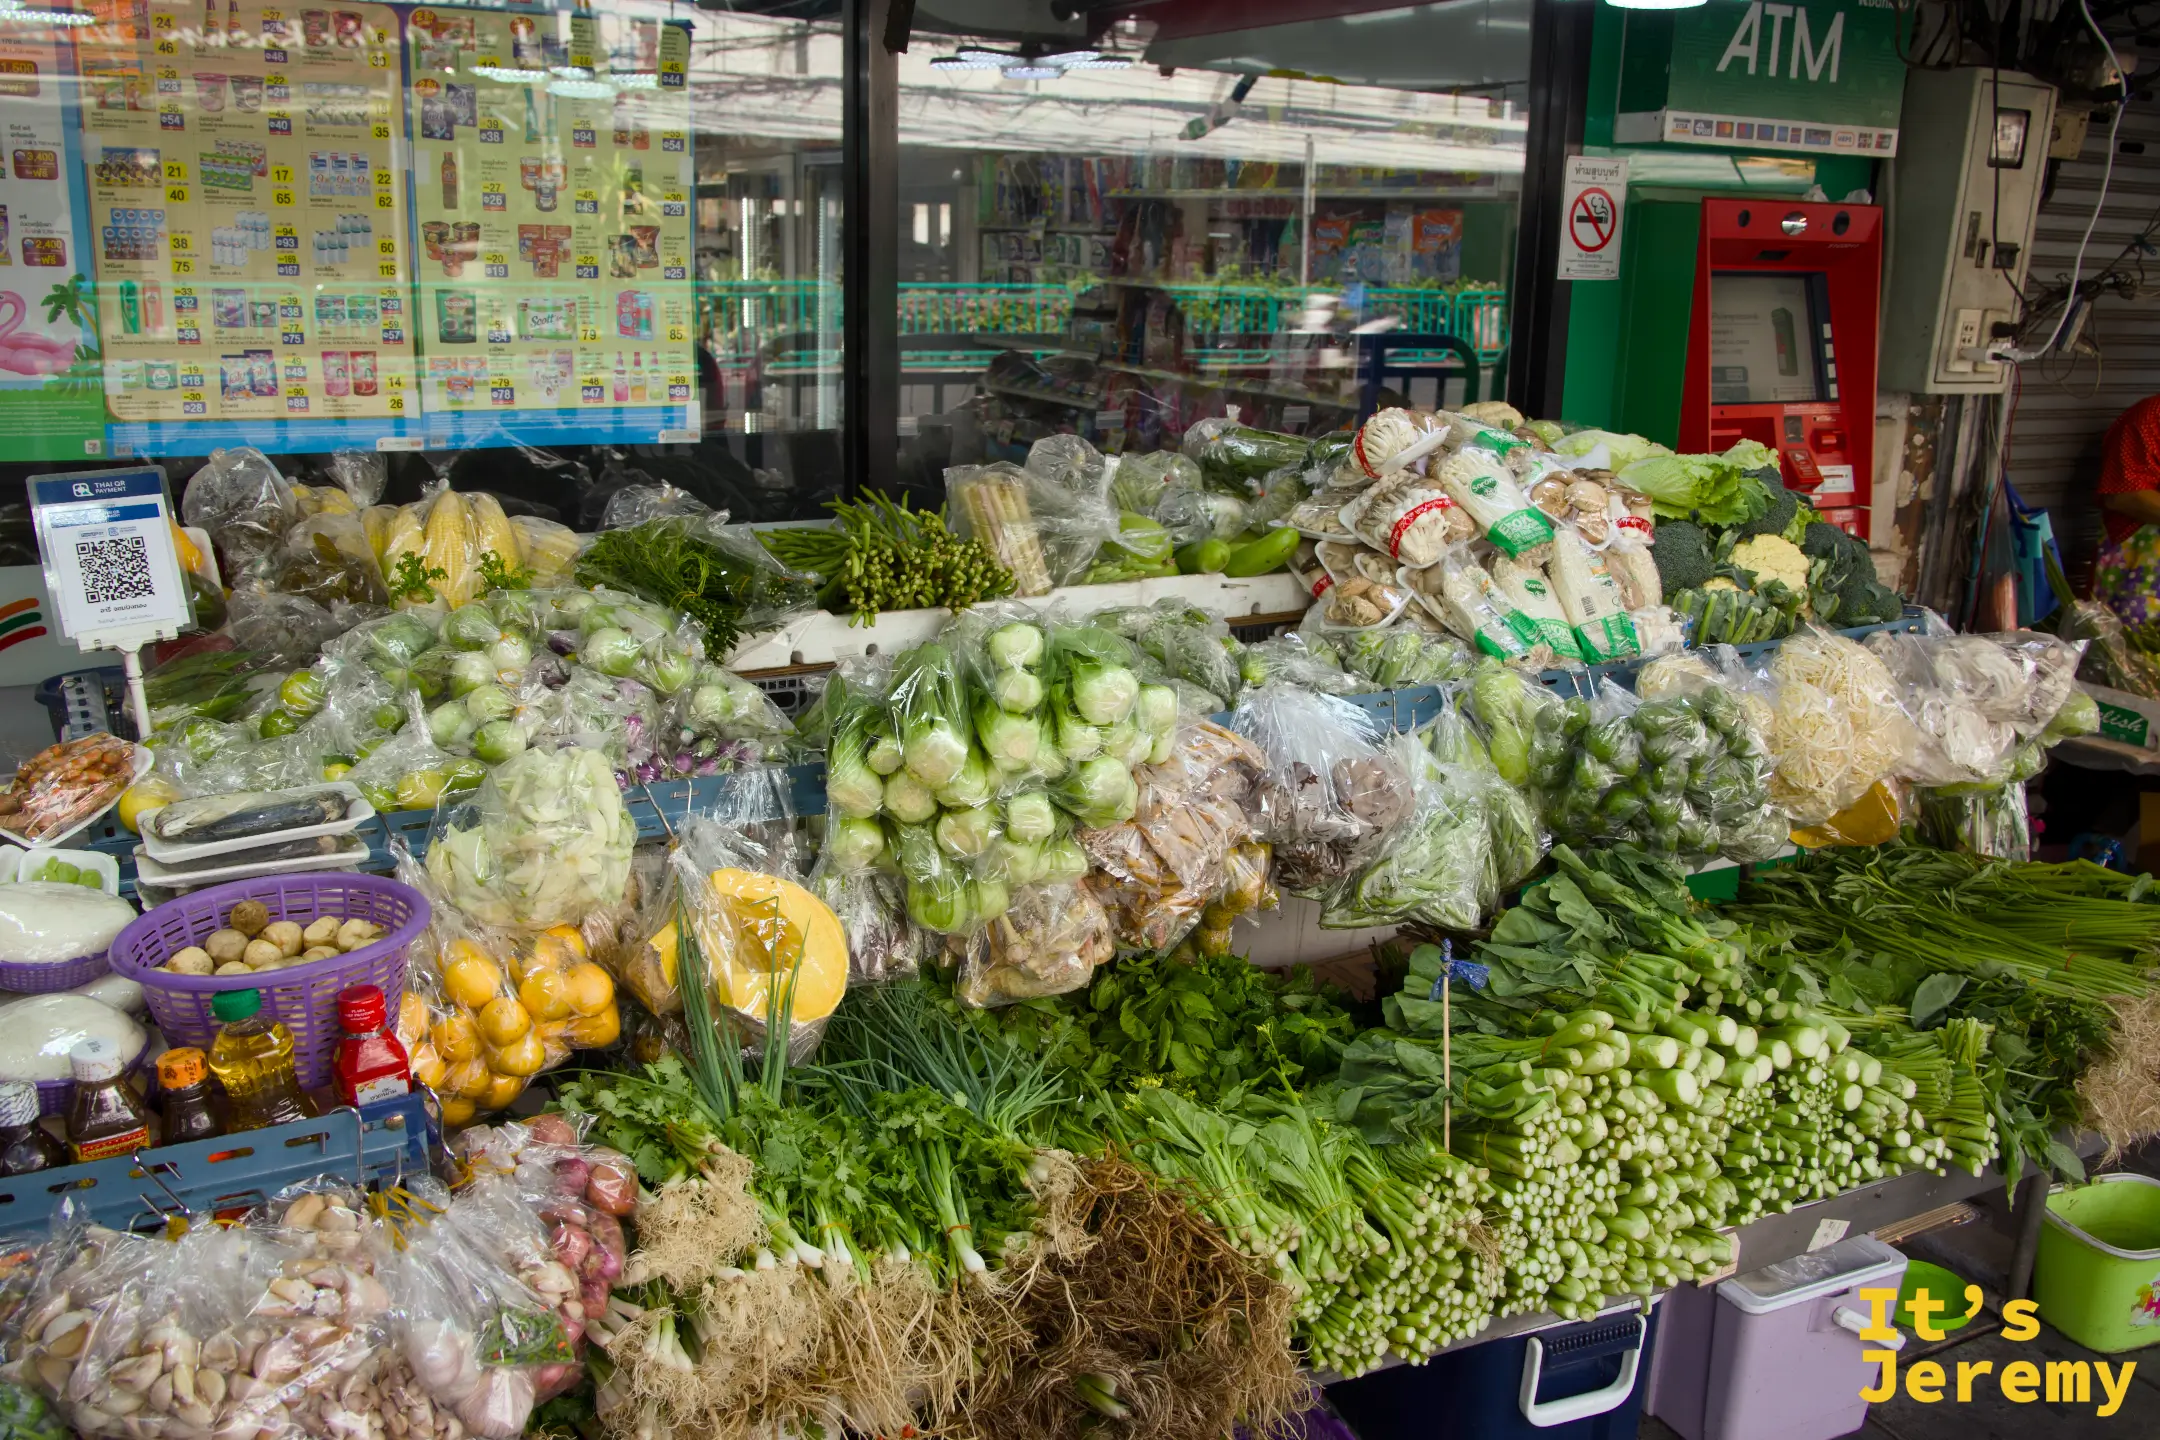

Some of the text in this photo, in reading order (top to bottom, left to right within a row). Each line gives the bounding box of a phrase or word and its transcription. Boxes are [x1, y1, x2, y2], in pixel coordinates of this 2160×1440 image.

[269, 11, 280, 20] 27
[156, 16, 172, 28] 24
[1716, 0, 1845, 83] ATM
[158, 42, 174, 53] 46
[668, 63, 680, 71] 45
[164, 70, 177, 79] 29
[273, 76, 285, 84] 22
[668, 76, 680, 84] 44
[273, 87, 285, 96] 21
[167, 114, 181, 125] 54
[275, 119, 288, 130] 40
[487, 119, 498, 128] 39
[375, 126, 390, 138] 35
[486, 132, 500, 141] 38
[580, 131, 592, 142] 94
[669, 139, 681, 150] 54
[167, 165, 181, 177] 21
[274, 170, 289, 182] 17
[1574, 163, 1620, 181] ห้ามสูบบุหรี่
[377, 173, 391, 185] 22
[490, 183, 501, 193] 27
[169, 190, 185, 201] 40
[276, 193, 291, 204] 65
[583, 190, 594, 199] 46
[671, 193, 682, 202] 30
[378, 196, 393, 208] 62
[490, 195, 503, 205] 26
[581, 202, 594, 212] 45
[670, 205, 682, 215] 29
[282, 227, 294, 236] 94
[35, 238, 62, 250] 2,400
[172, 238, 188, 249] 38
[282, 238, 294, 247] 93
[380, 242, 395, 253] 60
[492, 254, 504, 263] 20
[583, 256, 594, 265] 22
[175, 261, 191, 272] 75
[379, 264, 396, 275] 115
[492, 267, 505, 277] 19
[583, 268, 595, 277] 21
[670, 268, 682, 278] 25
[181, 287, 193, 296] 33
[386, 289, 397, 298] 30
[181, 297, 195, 307] 32
[286, 297, 298, 306] 39
[386, 299, 399, 309] 29
[286, 307, 299, 316] 38
[530, 312, 556, 328] Scott
[288, 323, 299, 332] 77
[288, 333, 301, 343] 75
[388, 329, 400, 340] 57
[582, 329, 597, 341] 79
[669, 329, 683, 341] 85
[188, 366, 199, 374] 19
[388, 376, 401, 387] 14
[498, 378, 510, 386] 79
[588, 377, 599, 386] 48
[675, 376, 686, 384] 69
[292, 387, 305, 396] 90
[498, 389, 510, 400] 78
[588, 387, 599, 398] 47
[189, 392, 202, 402] 30
[189, 403, 203, 413] 28
[390, 398, 404, 409] 26
[95, 486, 127, 495] PAYMENT
